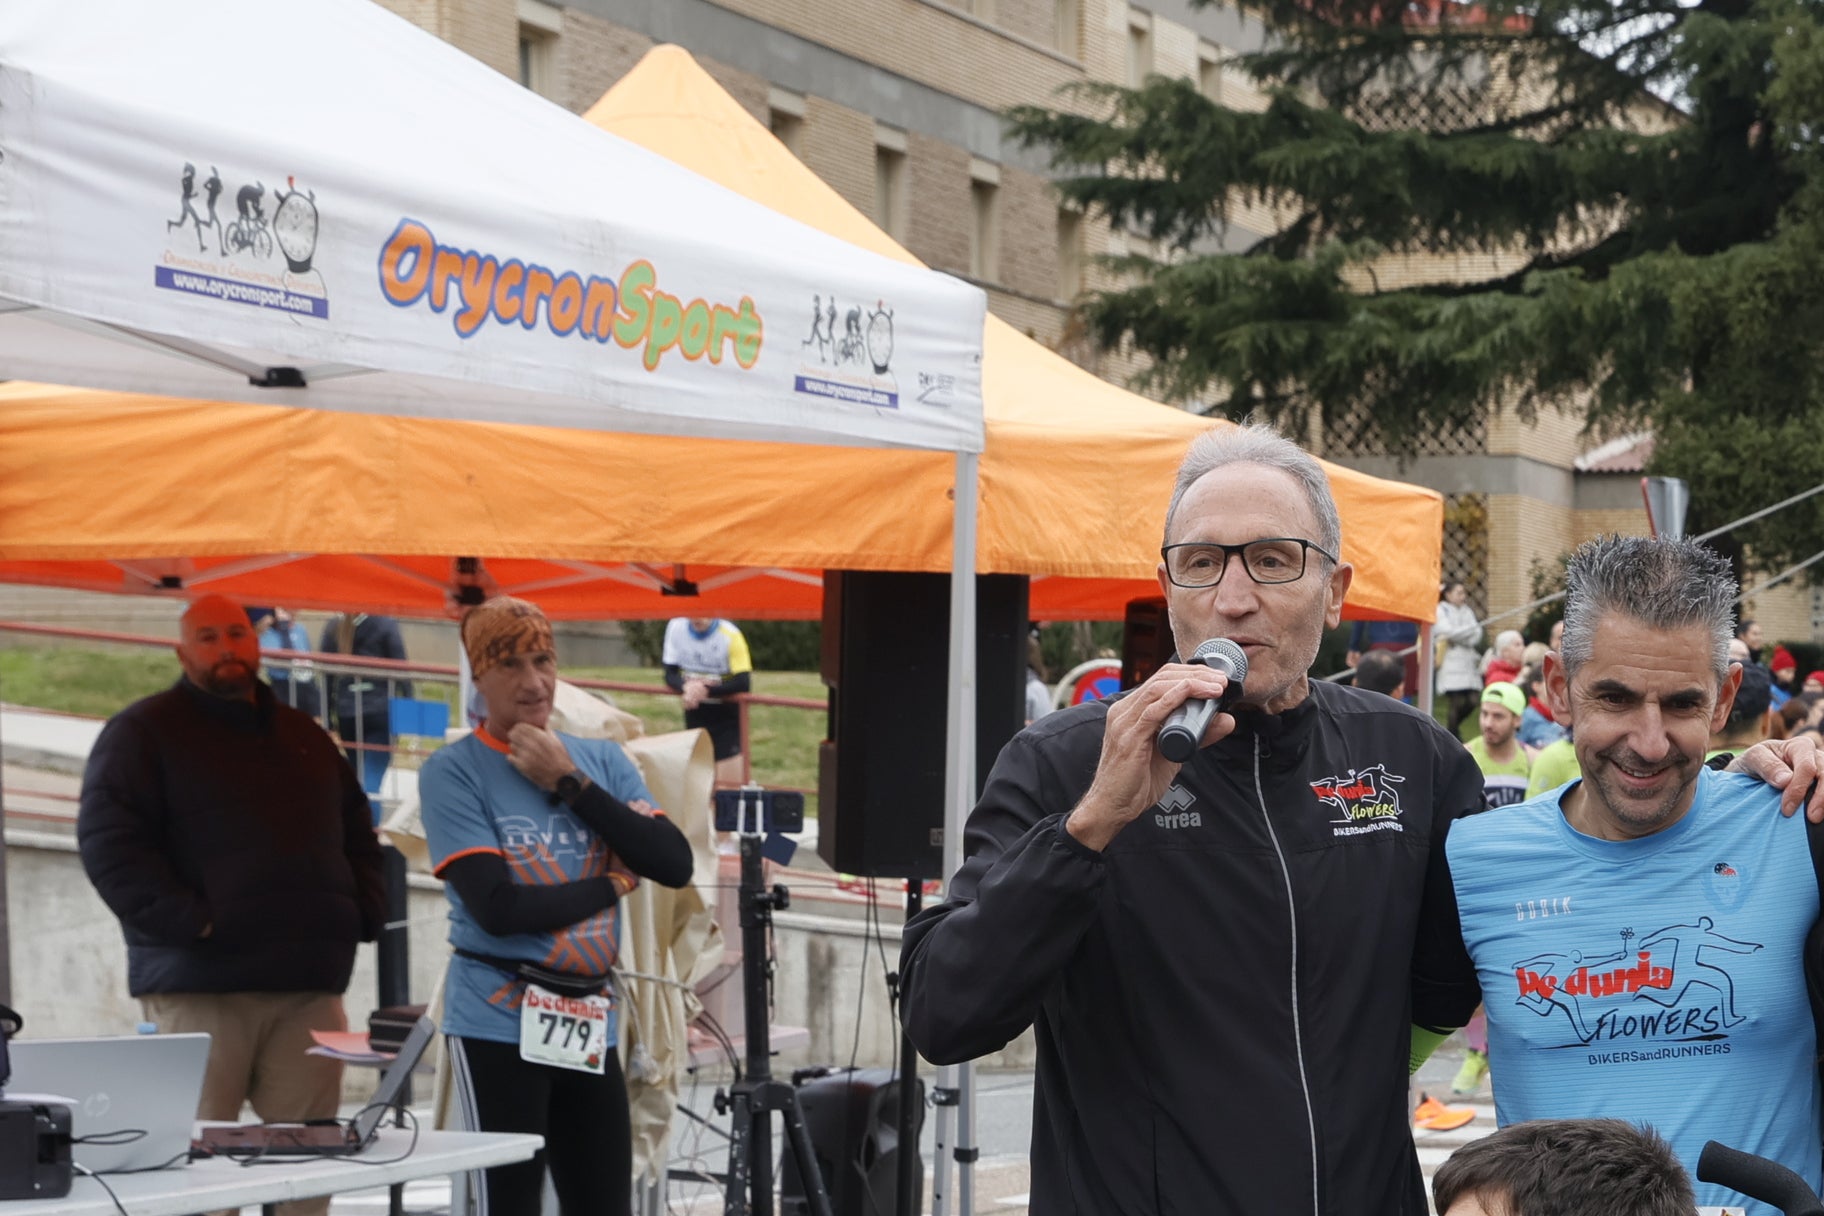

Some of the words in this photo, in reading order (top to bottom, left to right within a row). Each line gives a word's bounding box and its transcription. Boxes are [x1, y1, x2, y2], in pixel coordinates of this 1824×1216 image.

[173, 272, 313, 313] www.orycronsport.com
[378, 218, 762, 371] OrycronSport
[1155, 812, 1202, 829] errea
[1351, 804, 1395, 820] FLOWERS
[539, 1012, 591, 1052] 779
[1596, 1006, 1720, 1041] FLOWERS
[1588, 1043, 1732, 1065] BIKERSandRUNNERS
